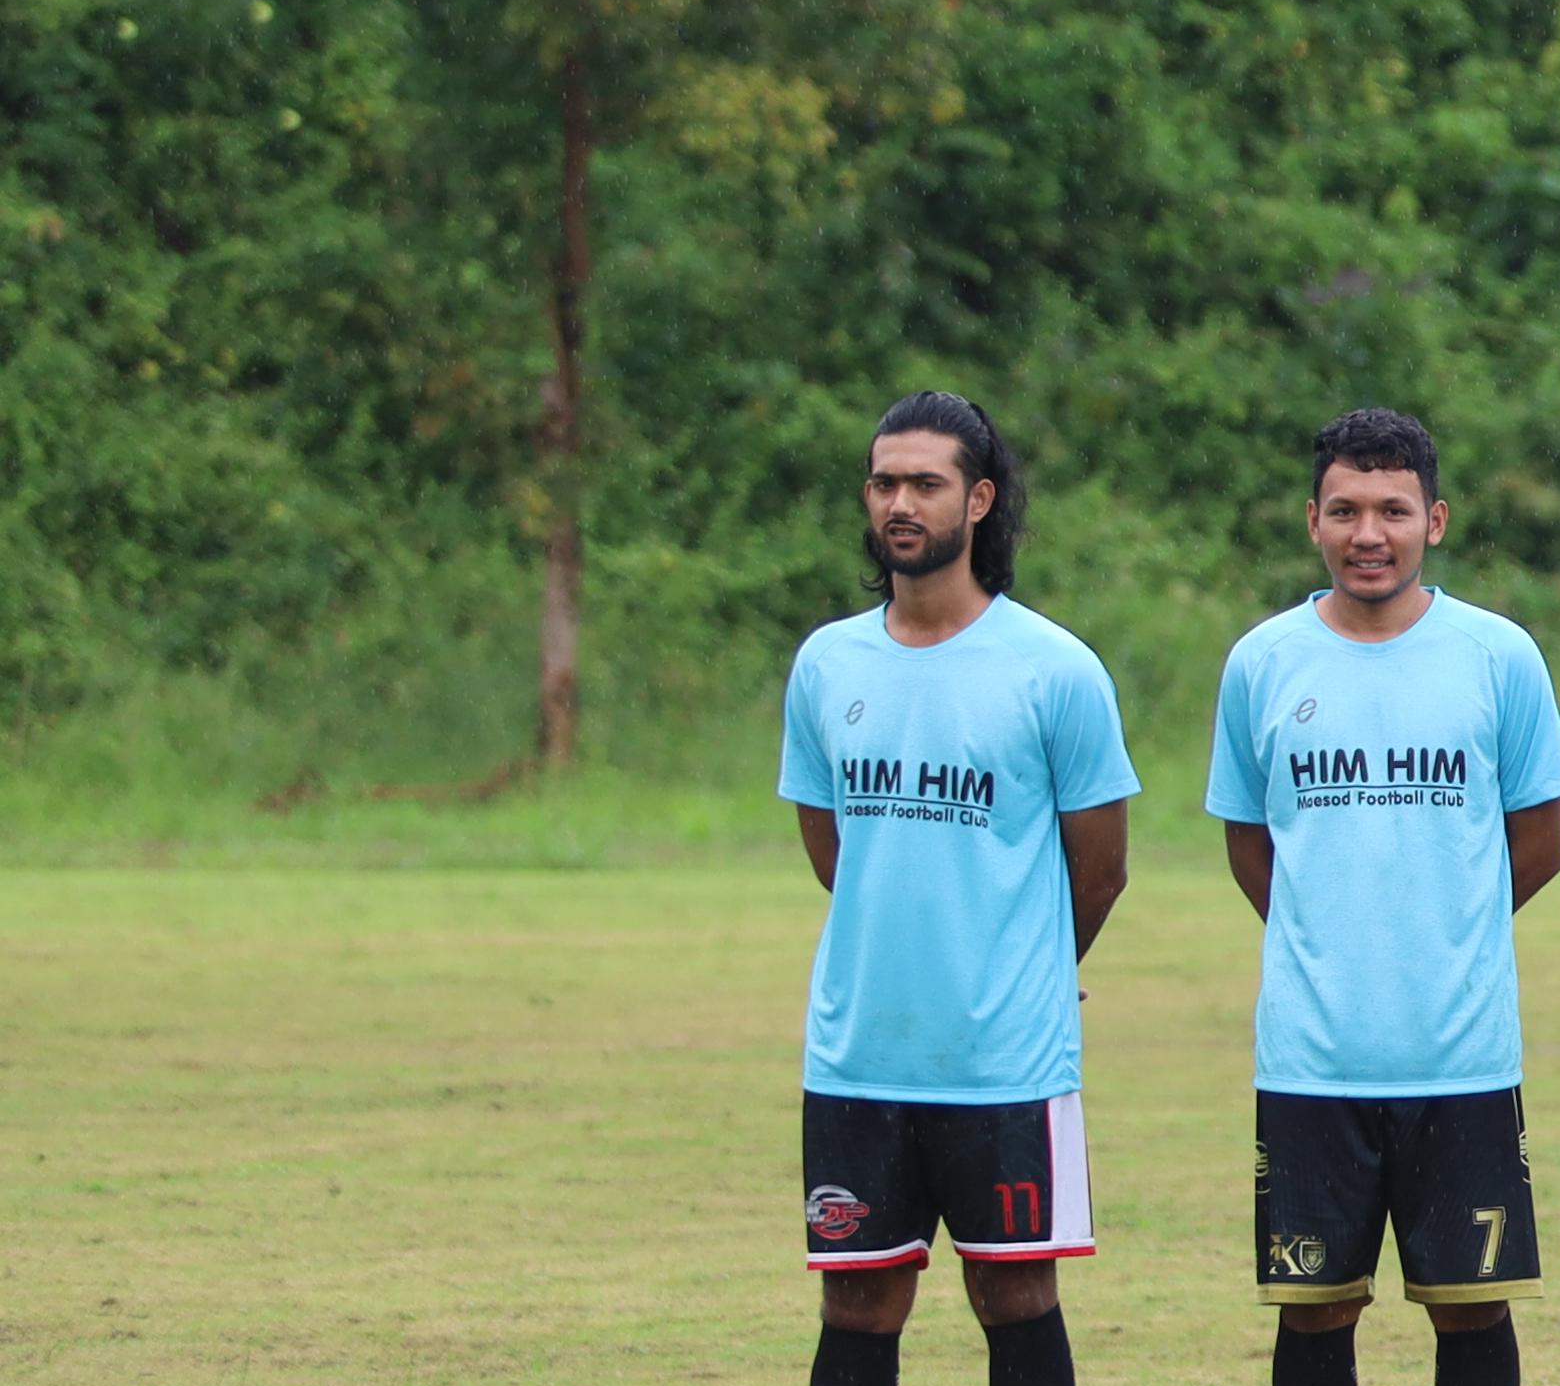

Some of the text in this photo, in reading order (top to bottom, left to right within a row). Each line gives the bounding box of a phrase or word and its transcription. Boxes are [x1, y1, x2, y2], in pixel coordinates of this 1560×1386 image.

[918, 761, 994, 807] HIM
[1290, 747, 1466, 787] HIM HIM
[891, 803, 953, 823] Football
[959, 810, 989, 828] Club
[1297, 791, 1464, 810] Maesod Football Club
[1472, 1206, 1506, 1277] 7
